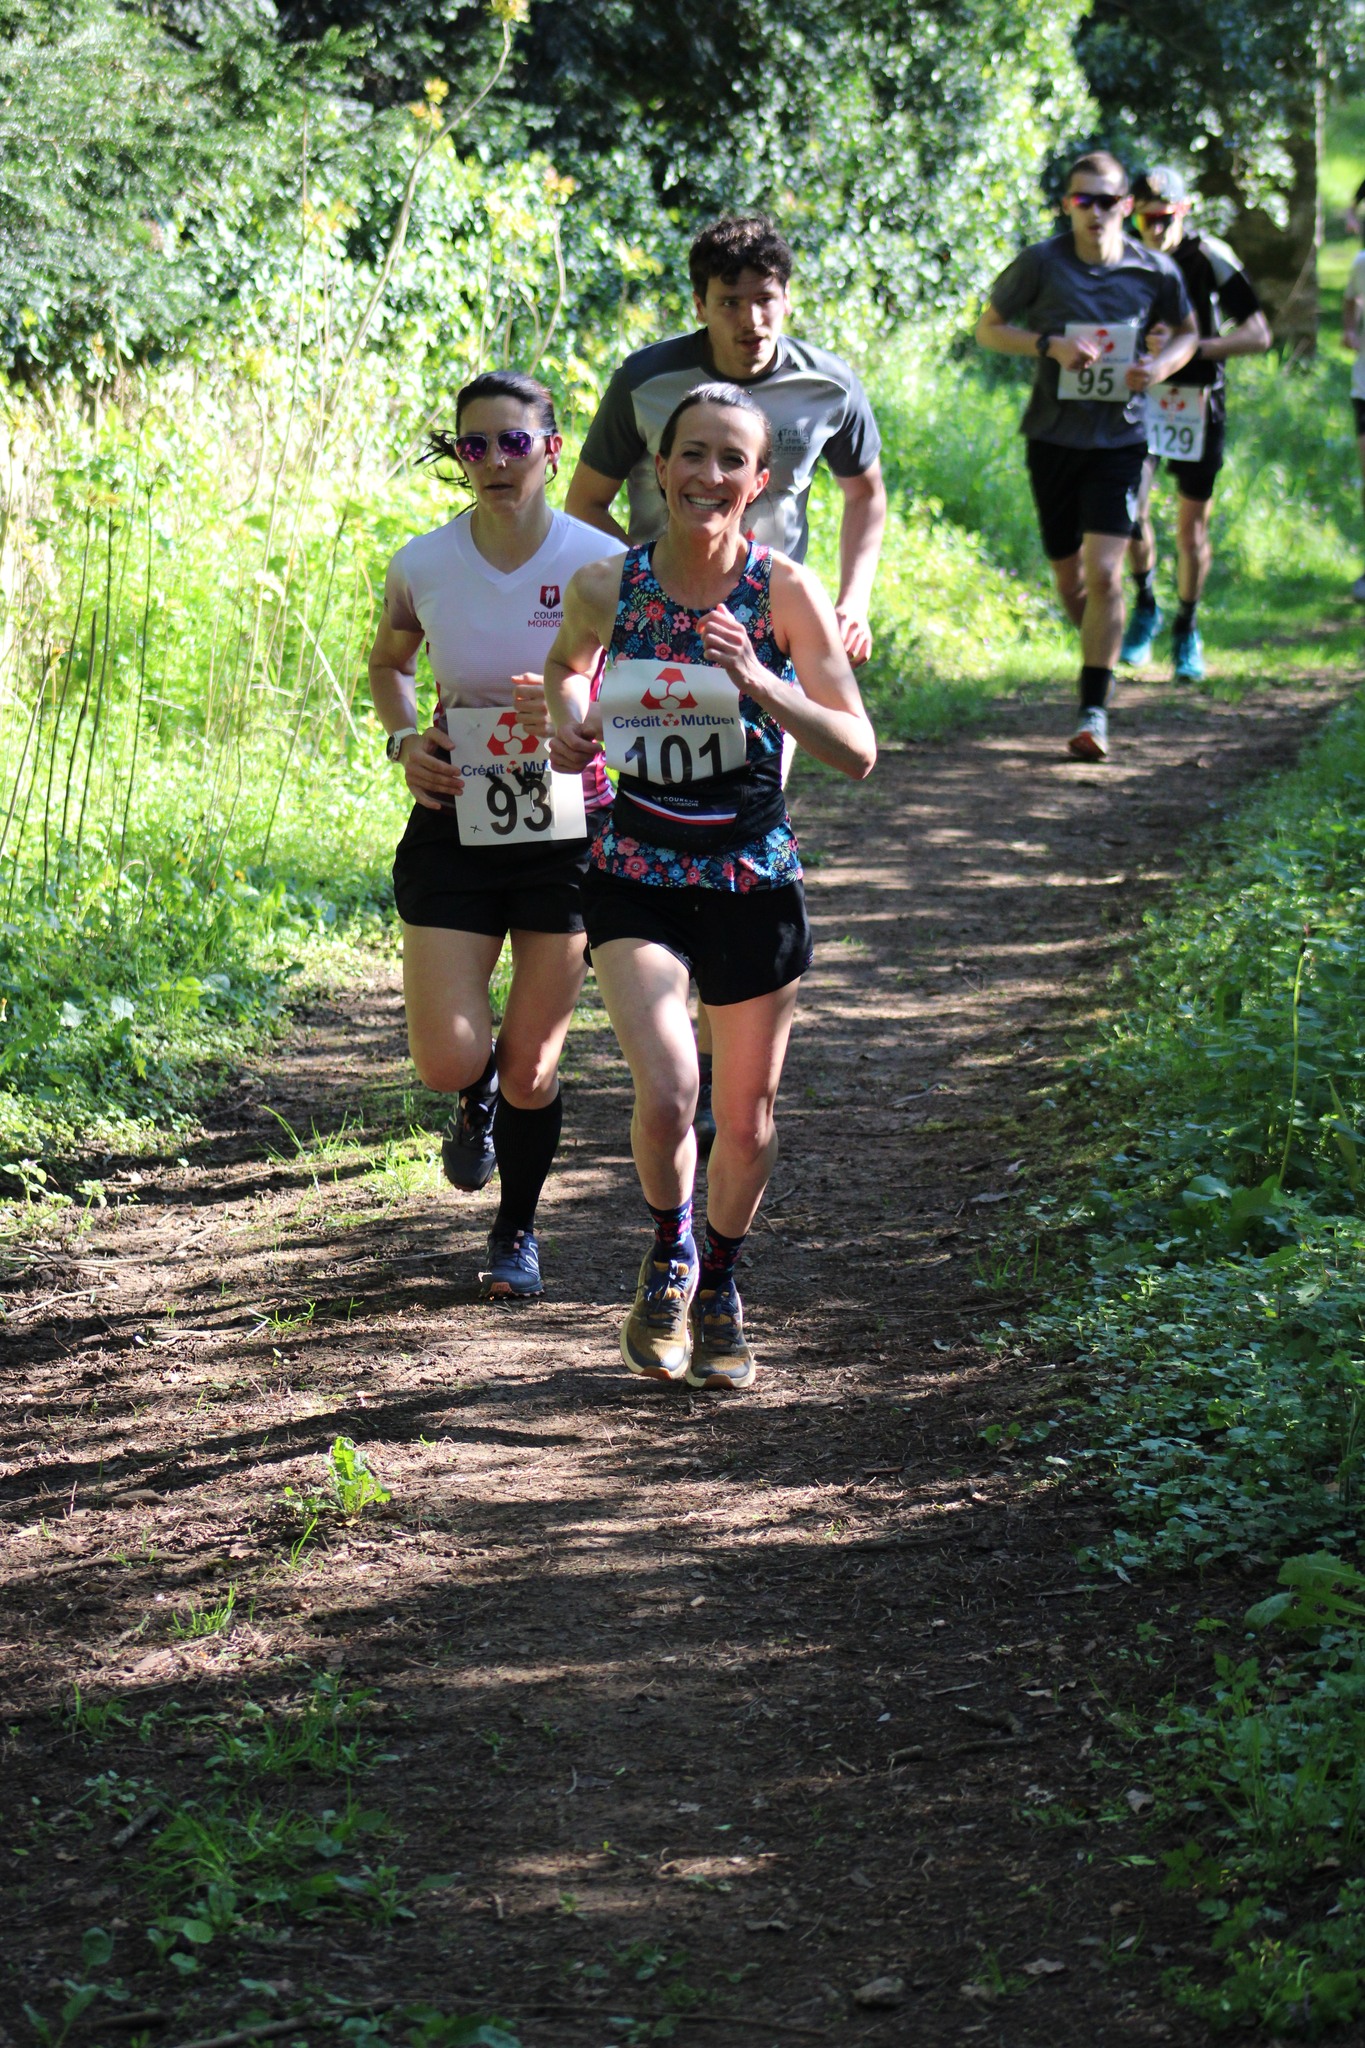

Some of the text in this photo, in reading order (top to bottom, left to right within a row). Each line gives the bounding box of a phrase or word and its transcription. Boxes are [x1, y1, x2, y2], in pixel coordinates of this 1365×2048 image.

[1077, 368, 1114, 396] 95
[1151, 424, 1195, 454] 129
[612, 714, 735, 729] Crédit Mutuel
[461, 764, 505, 777] Crédit
[625, 733, 723, 785] 101
[487, 779, 552, 836] 93
